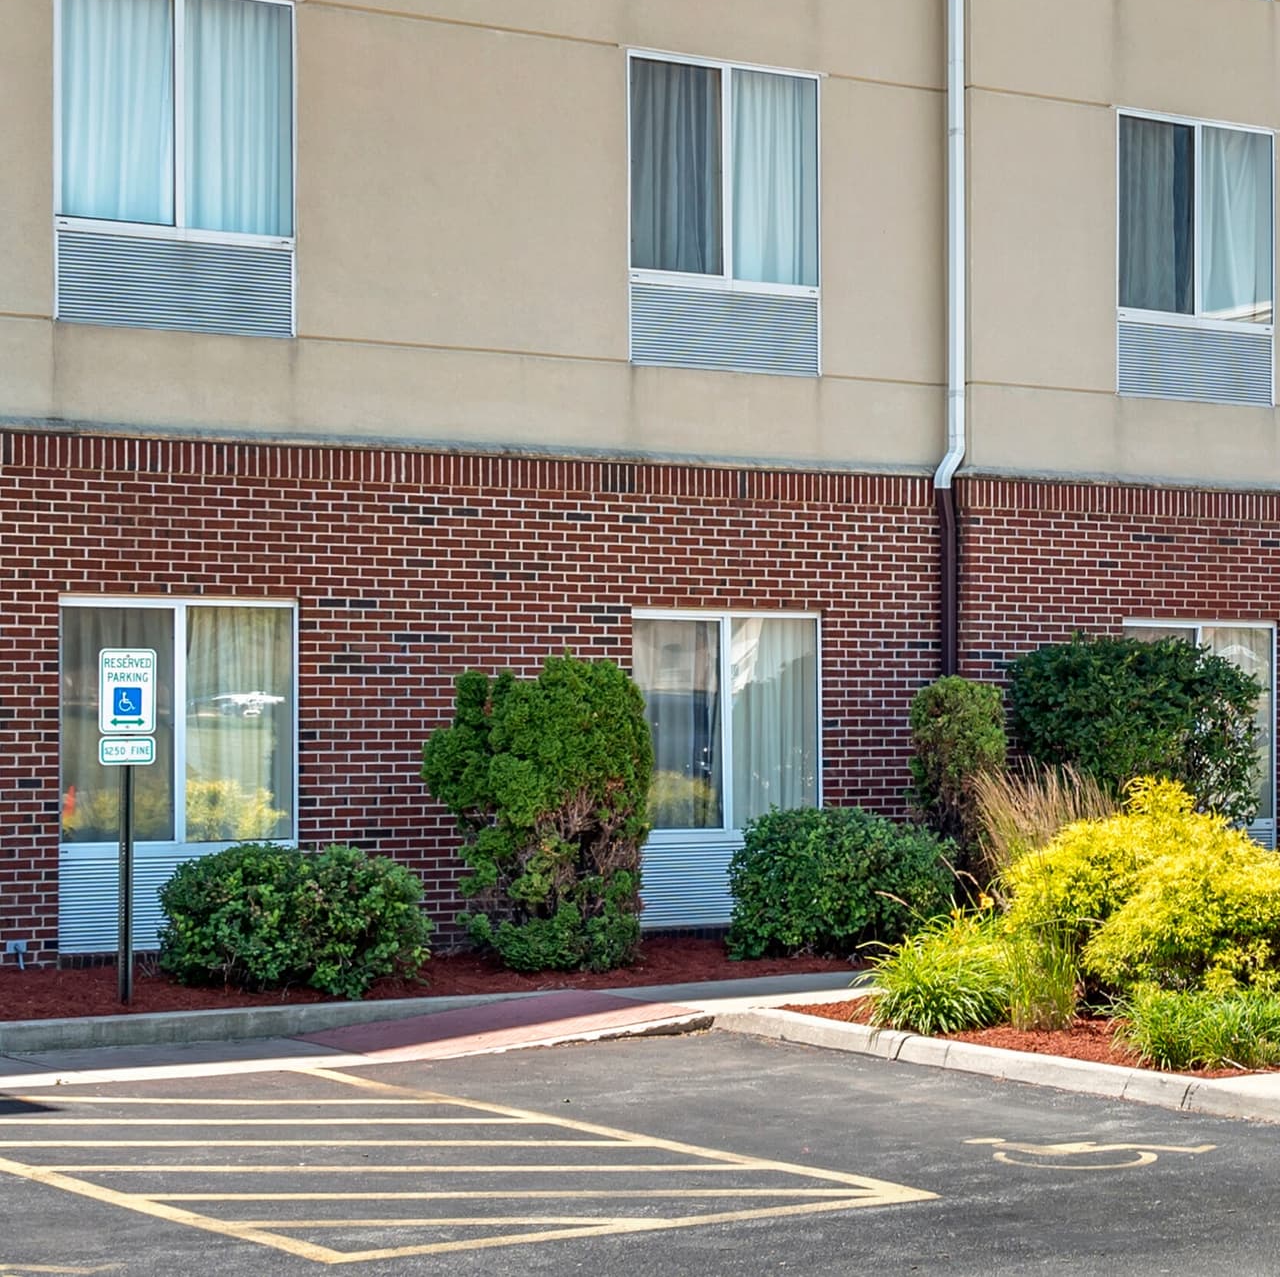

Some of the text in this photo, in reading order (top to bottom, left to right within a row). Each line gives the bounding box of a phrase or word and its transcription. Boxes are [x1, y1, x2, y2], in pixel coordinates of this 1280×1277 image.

[103, 657, 152, 669] RESERVED
[107, 671, 149, 683] PARKING
[104, 745, 151, 756] $250 FINE
